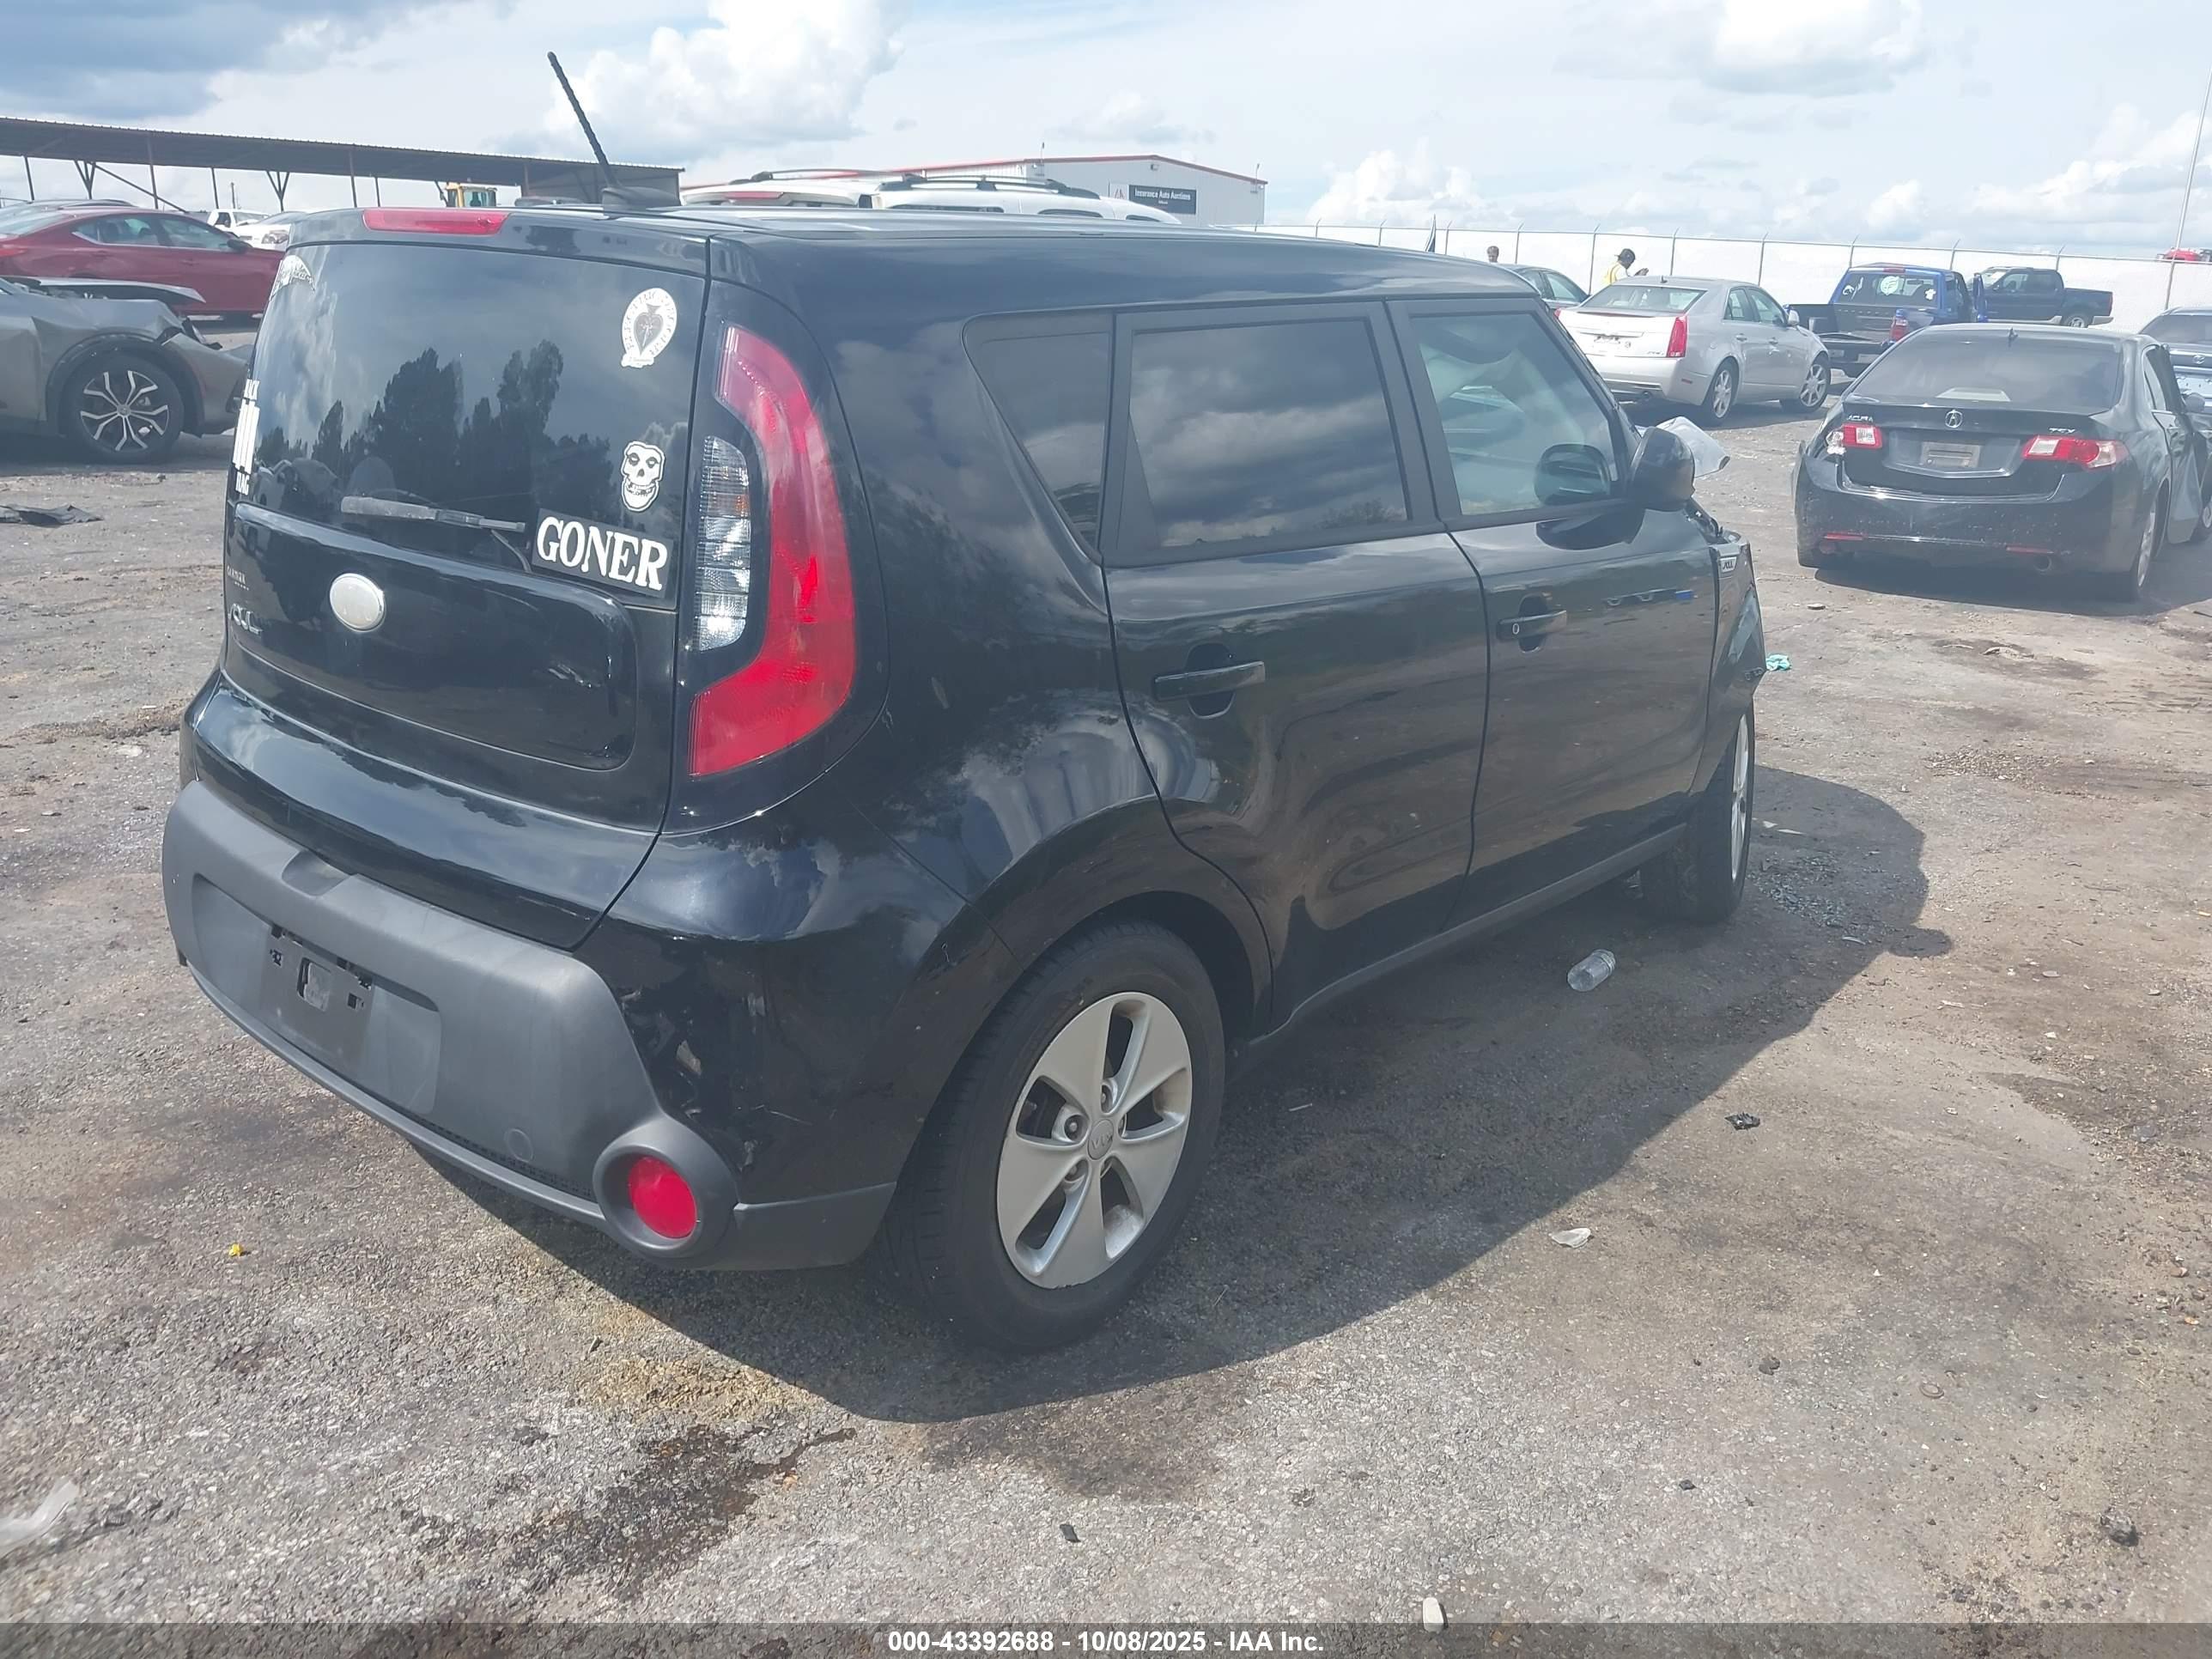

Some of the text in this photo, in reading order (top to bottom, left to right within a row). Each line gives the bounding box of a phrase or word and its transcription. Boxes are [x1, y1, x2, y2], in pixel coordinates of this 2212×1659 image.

[1134, 188, 1191, 201] Insurance Auto Auctions
[1846, 415, 1874, 423] ACURA
[537, 516, 668, 591] GONER
